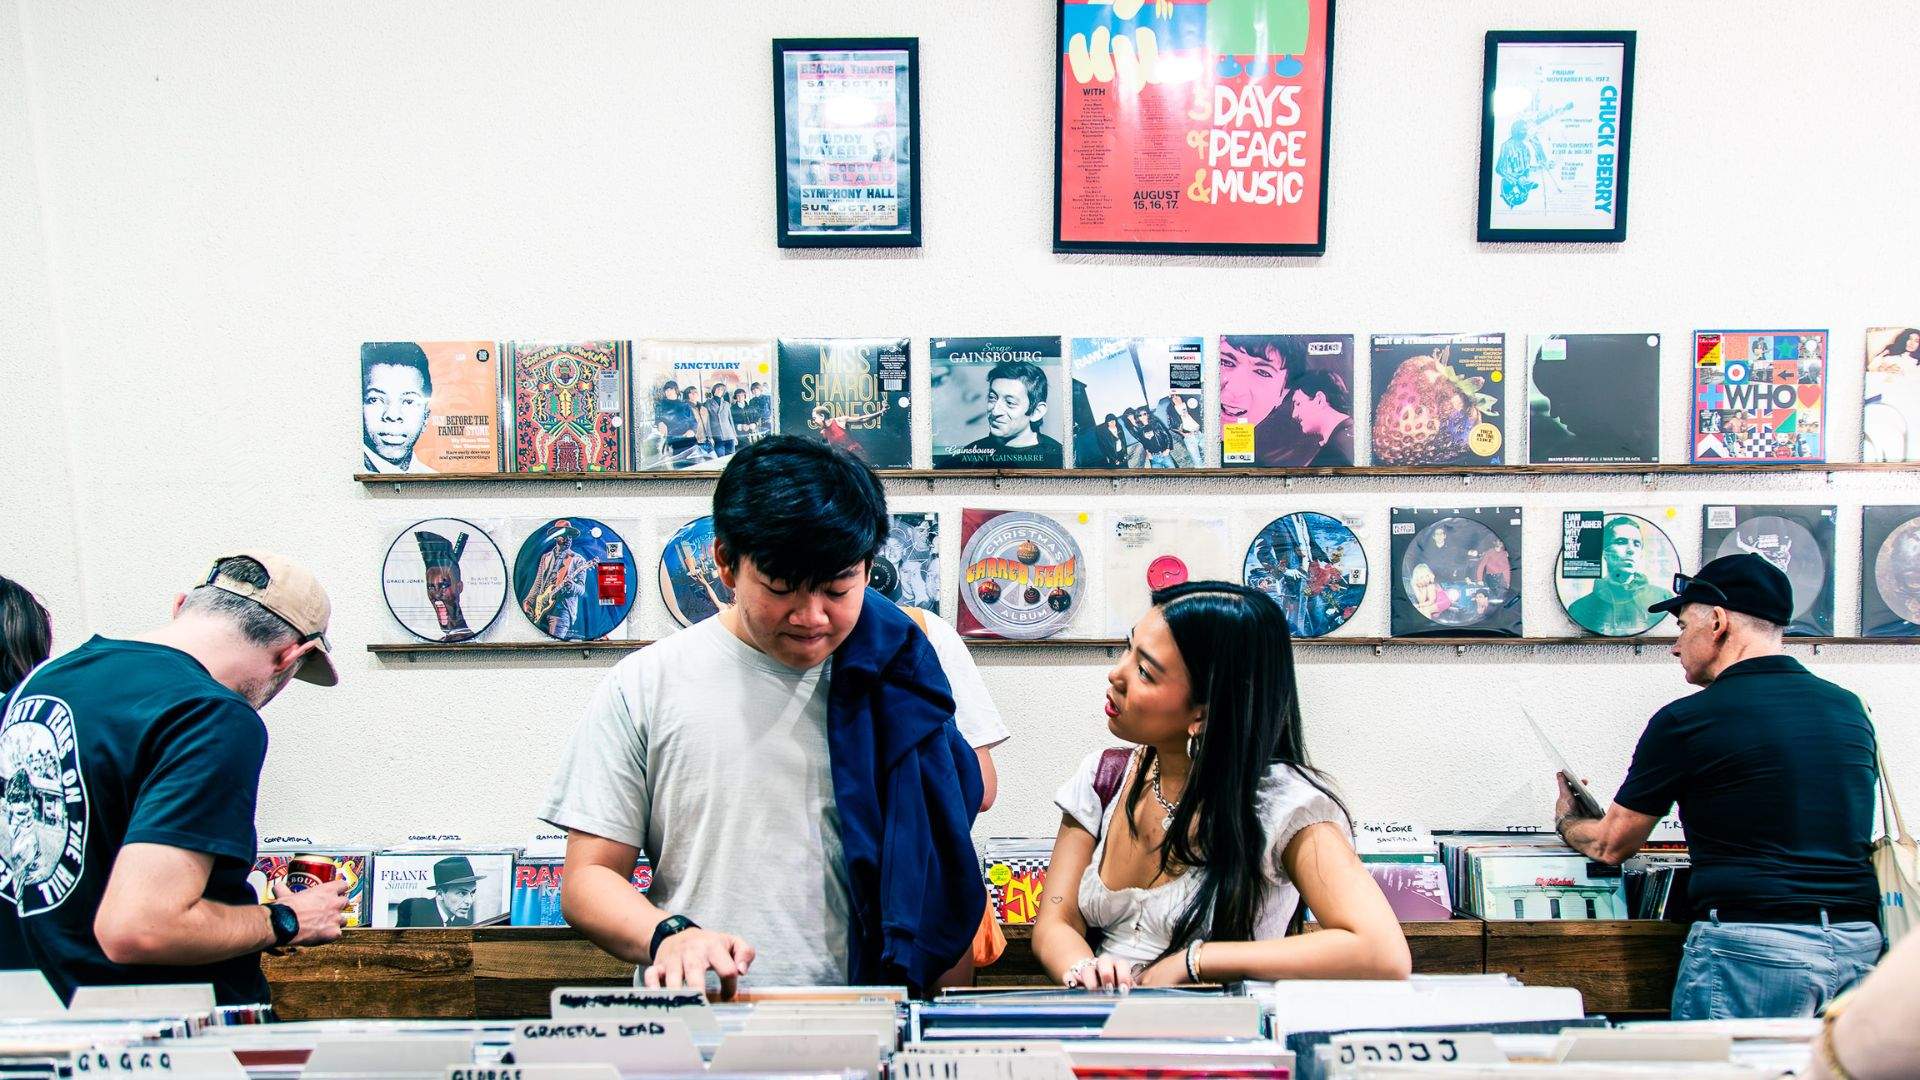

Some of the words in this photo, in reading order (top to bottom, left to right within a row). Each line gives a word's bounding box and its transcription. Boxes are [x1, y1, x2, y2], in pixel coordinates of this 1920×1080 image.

[850, 64, 894, 74] THEATRE
[1082, 88, 1106, 96] WITH
[1213, 85, 1302, 128] DAYS
[1598, 85, 1618, 148] CHUCK
[1208, 130, 1307, 168] PEACE
[1187, 168, 1210, 203] &
[1210, 170, 1304, 206] MUSIC
[1595, 153, 1615, 214] BERRY
[802, 188, 862, 199] SYMPHONY
[866, 188, 895, 199] HALL
[1133, 190, 1181, 200] AUGUST
[801, 203, 833, 211] SUN.
[1133, 201, 1148, 210] 15,
[1150, 201, 1165, 210] 16,
[1166, 201, 1179, 210] 17.
[982, 342, 1014, 354] Serge
[949, 351, 1043, 364] GAINSBOURG
[674, 362, 741, 370] SANCTUARY
[1724, 384, 1797, 410] WHO
[446, 415, 473, 426] BEFORE
[473, 415, 490, 426] THE
[438, 426, 465, 436] FAMILY
[944, 444, 997, 457] Gainsbourg
[961, 454, 989, 463] AVANT
[992, 454, 1044, 462] GAINSBARRE
[1564, 520, 1603, 529] GALLAGHER
[986, 529, 1065, 561] CHRISTMAS
[1001, 609, 1047, 620] ALBUM
[45, 702, 75, 760] YEARS
[62, 767, 83, 804] ON
[1385, 824, 1413, 833] COOKE
[65, 820, 83, 864] THE
[381, 870, 428, 881] FRANK
[384, 880, 418, 890] Sinatra
[523, 1025, 607, 1039] GRATEFUL
[617, 1022, 665, 1037] DEAD
